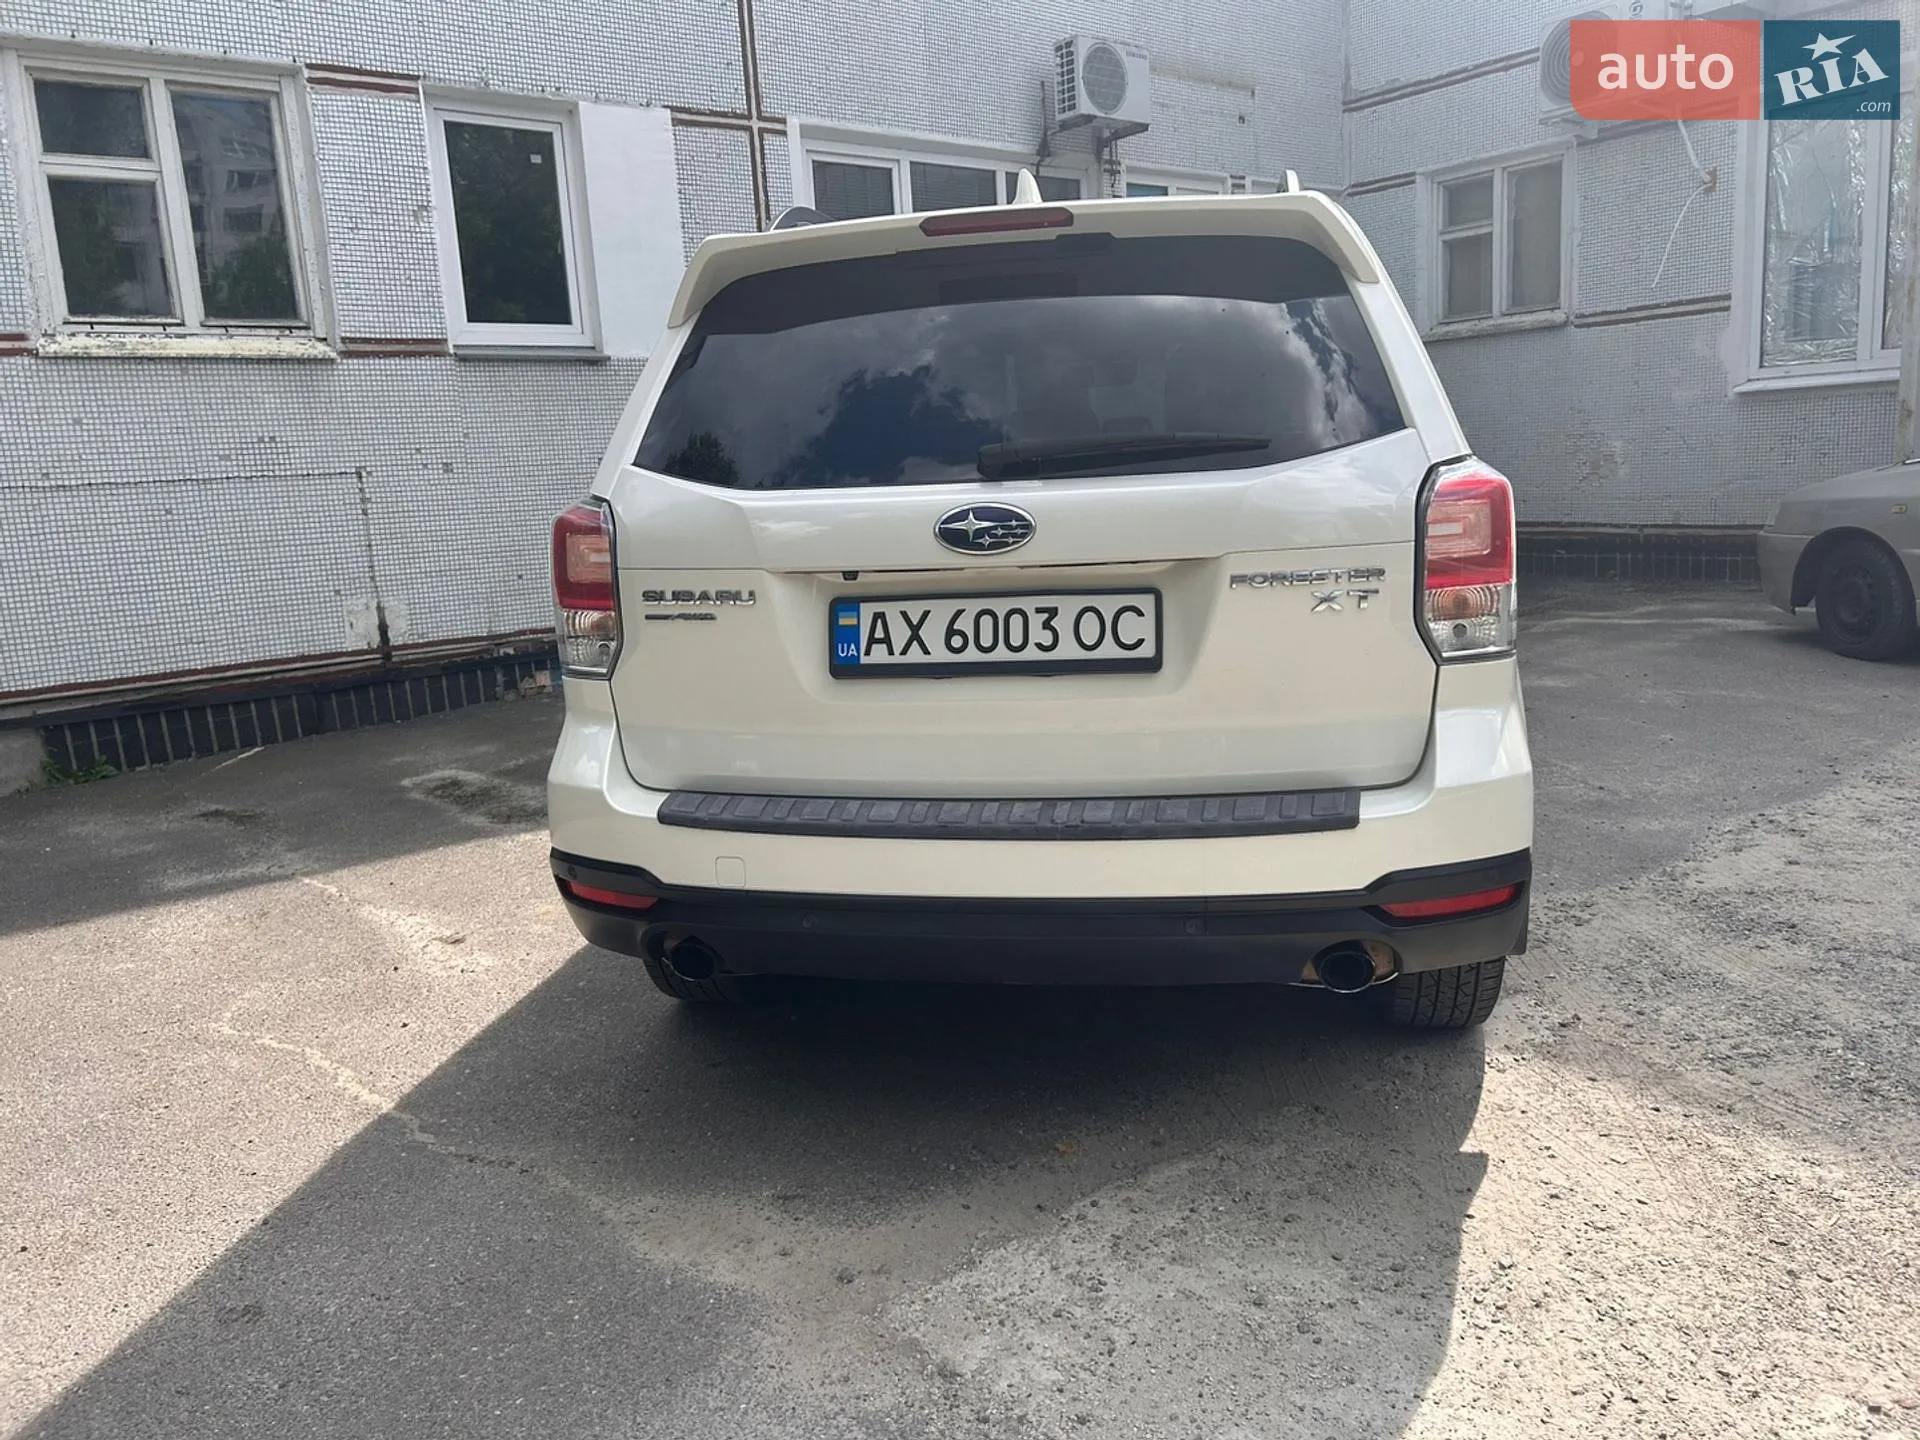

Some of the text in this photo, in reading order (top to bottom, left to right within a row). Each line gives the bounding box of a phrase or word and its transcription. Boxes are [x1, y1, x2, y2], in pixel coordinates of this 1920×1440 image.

[1230, 567, 1386, 590] FORESTER
[641, 589, 756, 606] SUBARU
[1310, 588, 1380, 614] XT
[863, 605, 1146, 657] AX 6003 OC
[838, 643, 858, 657] UA
